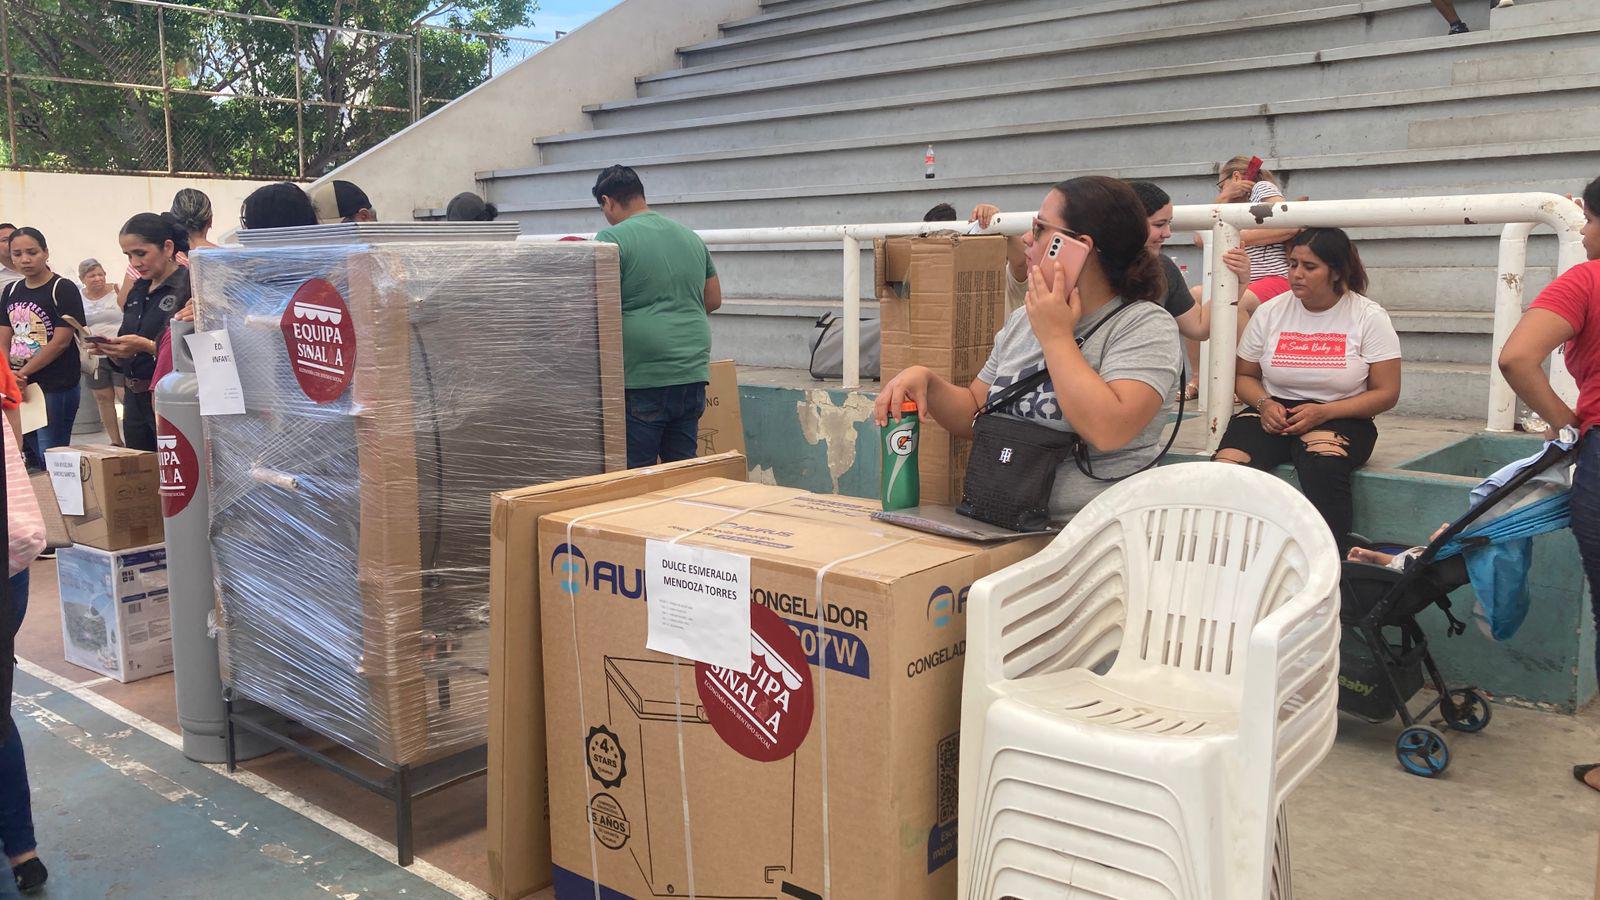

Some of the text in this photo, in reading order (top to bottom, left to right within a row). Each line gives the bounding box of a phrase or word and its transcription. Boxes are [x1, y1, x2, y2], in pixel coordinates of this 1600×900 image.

[29, 302, 54, 336] PRESENTS
[293, 322, 343, 344] EQUIPA
[1287, 341, 1332, 354] Santa Baby
[706, 397, 720, 408] NG
[662, 559, 738, 584] DULCE ESMERALDA
[663, 576, 738, 601] MENDOZA TORRES
[788, 624, 860, 667] 07W
[907, 640, 967, 678] CONGELAD
[747, 660, 791, 713] UIPA
[599, 738, 609, 753] 4
[754, 730, 772, 750] SOCIAL
[593, 753, 618, 769] STARS
[600, 814, 626, 833] AÑOS
